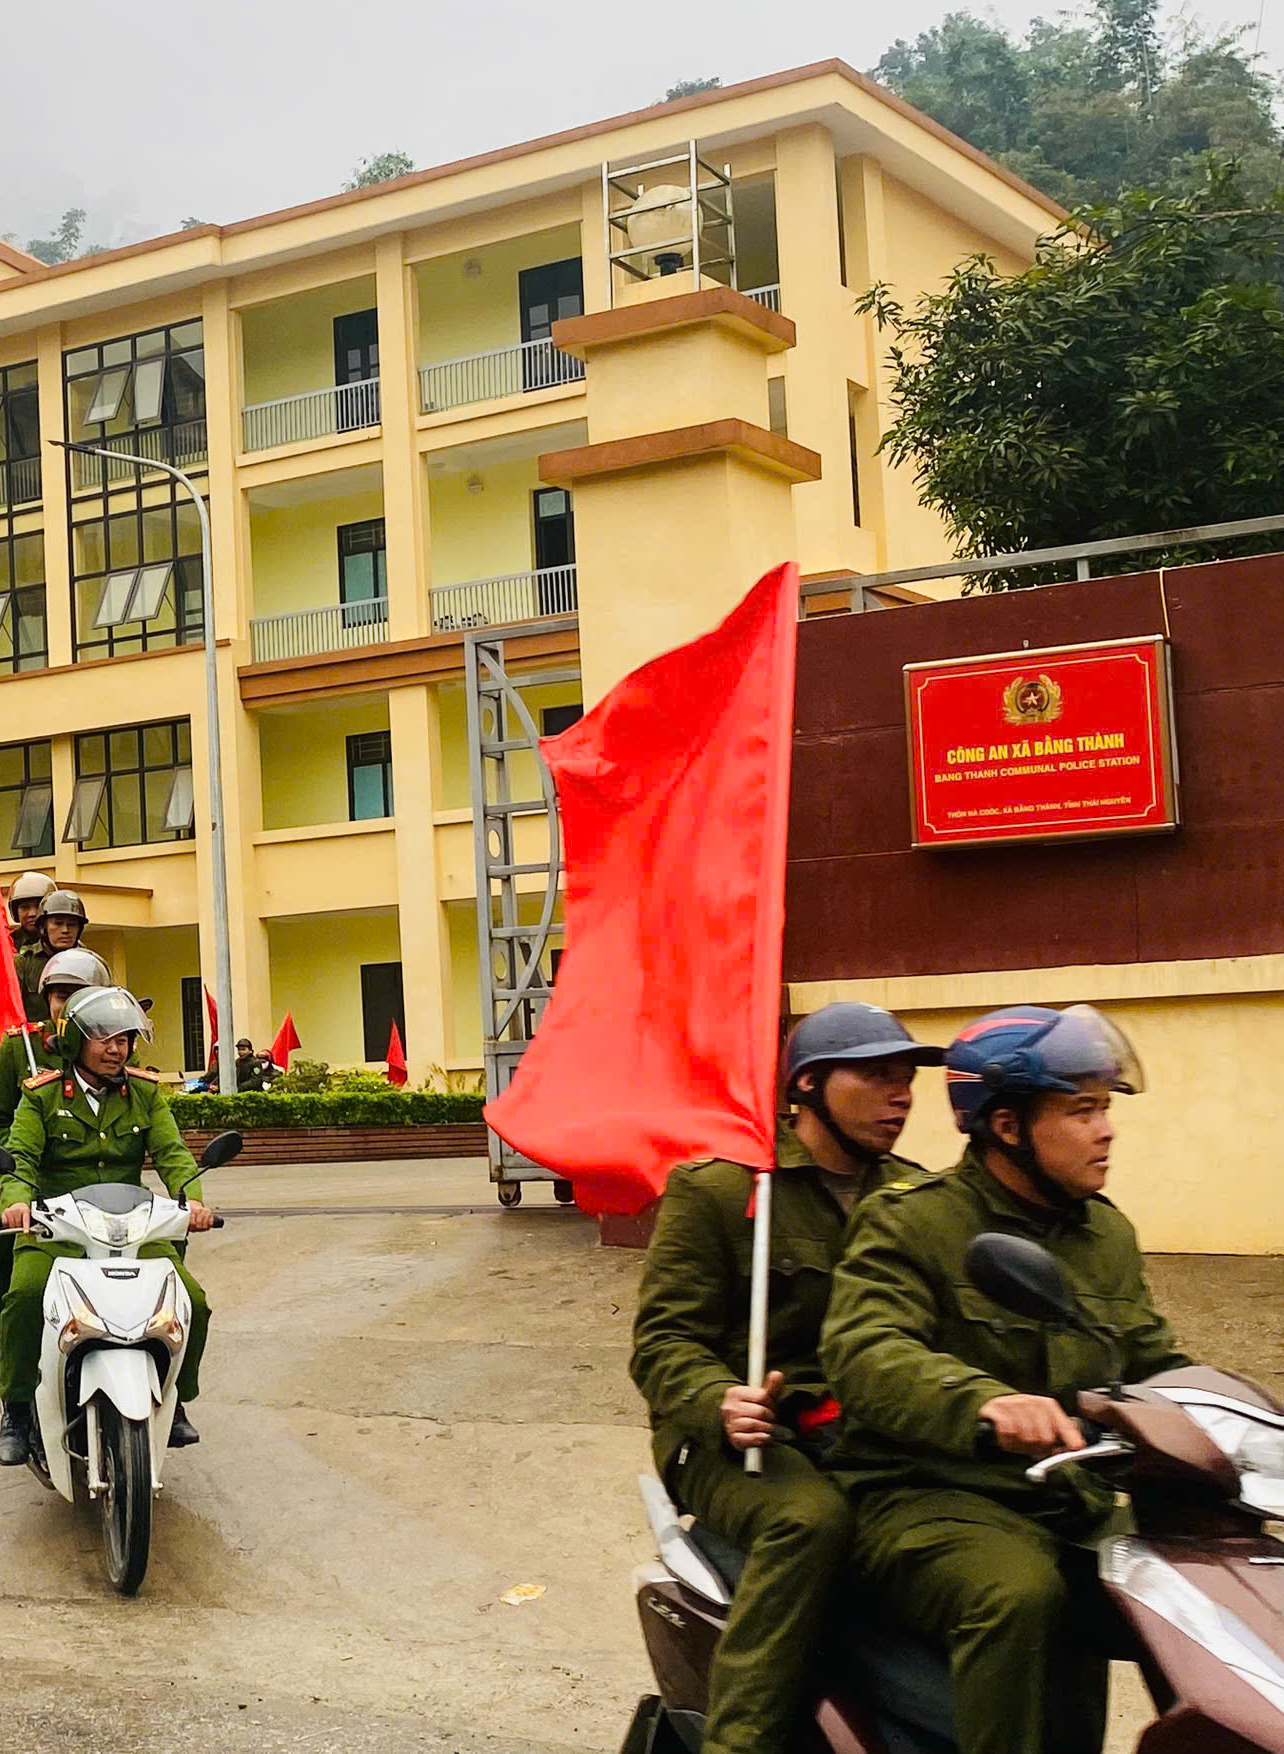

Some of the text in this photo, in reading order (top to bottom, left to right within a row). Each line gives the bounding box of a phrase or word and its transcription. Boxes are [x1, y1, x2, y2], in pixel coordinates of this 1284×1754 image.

[947, 745, 985, 764] CÔNG
[988, 745, 1008, 760] AN
[1012, 740, 1031, 758] XÃ
[1076, 732, 1124, 752] THÀNH
[935, 755, 1140, 783] BANG THANH COMMUNAL POLICE STATION
